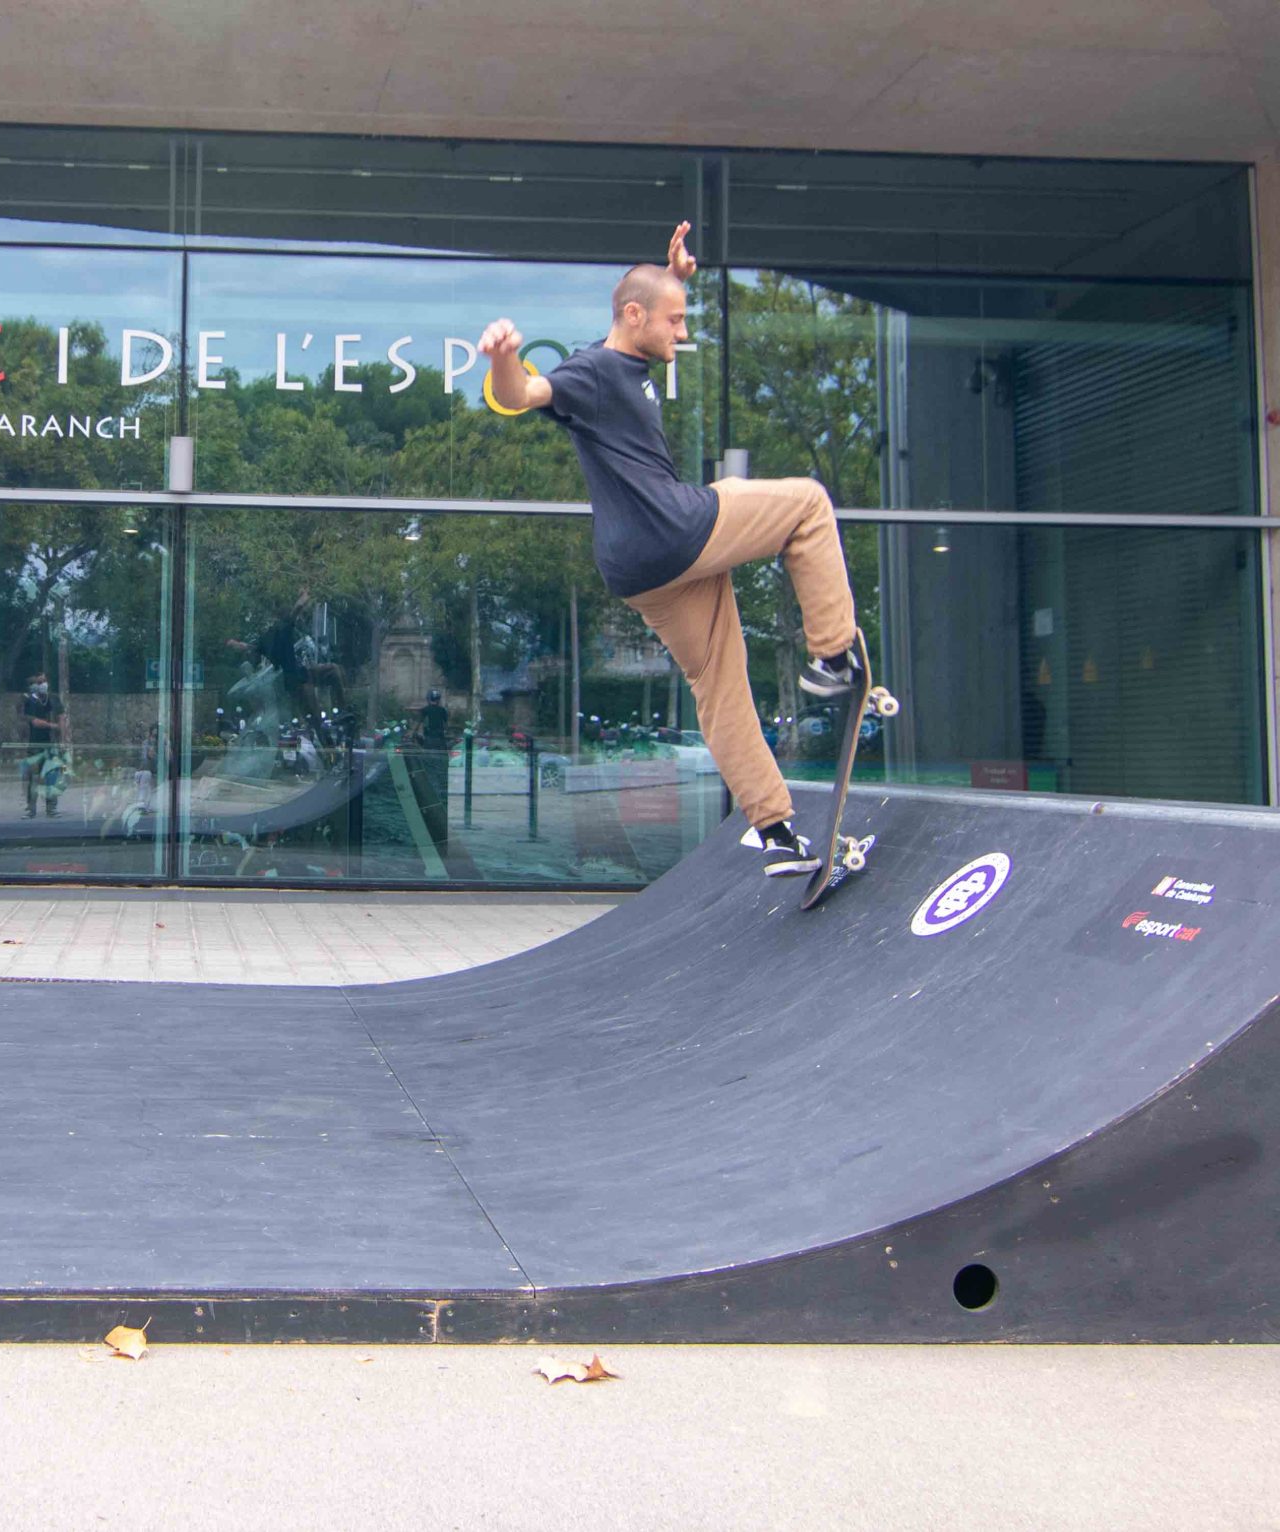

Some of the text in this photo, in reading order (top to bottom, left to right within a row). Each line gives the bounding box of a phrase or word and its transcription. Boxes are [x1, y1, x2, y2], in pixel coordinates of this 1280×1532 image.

[57, 327, 69, 385] I
[121, 329, 227, 390] DE
[275, 332, 698, 416] L'ESPOT
[1134, 919, 1201, 941] esportcat
